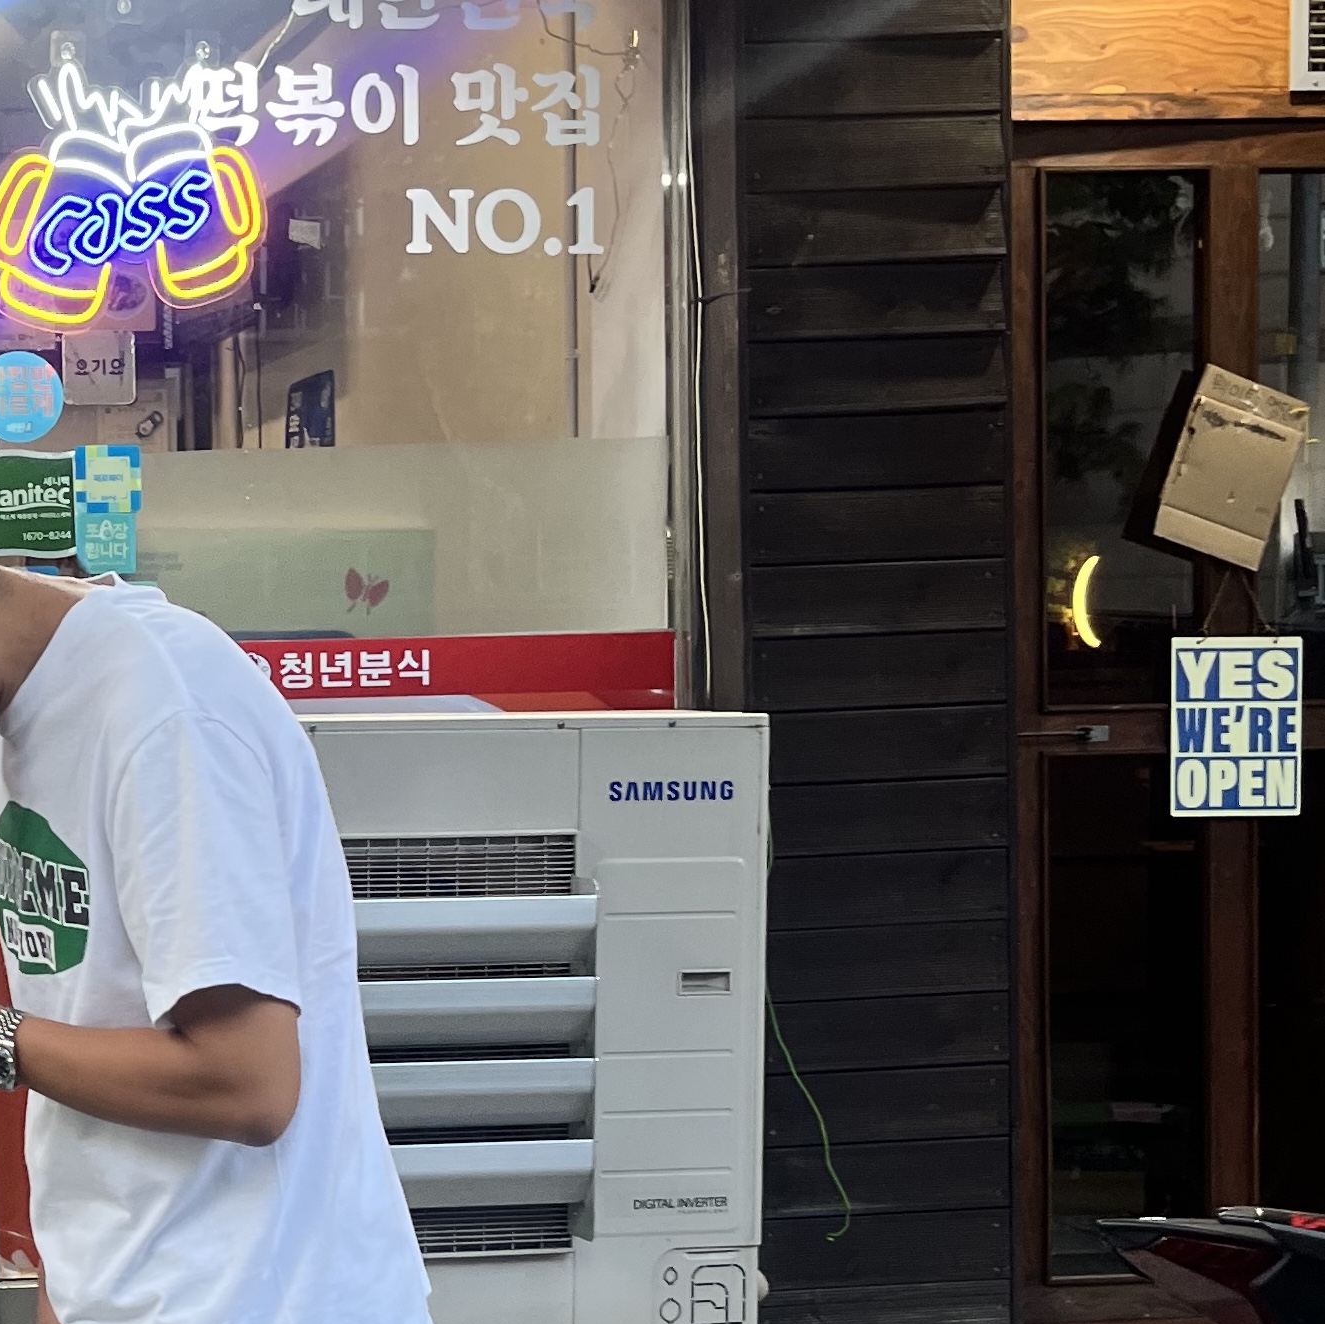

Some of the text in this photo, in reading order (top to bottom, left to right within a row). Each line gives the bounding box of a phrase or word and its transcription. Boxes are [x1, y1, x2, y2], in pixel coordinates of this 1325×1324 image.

[188, 63, 601, 146] 떡볶이 맛집
[404, 187, 605, 257] NO.1
[74, 357, 125, 376] 요기요
[277, 648, 432, 689] 청년분식
[1178, 649, 1294, 700] YES
[1178, 704, 1296, 753] WE'RE
[609, 779, 735, 803] SAMSUNG
[1177, 758, 1295, 808] OPEN
[633, 1198, 675, 1210] DIGITAL
